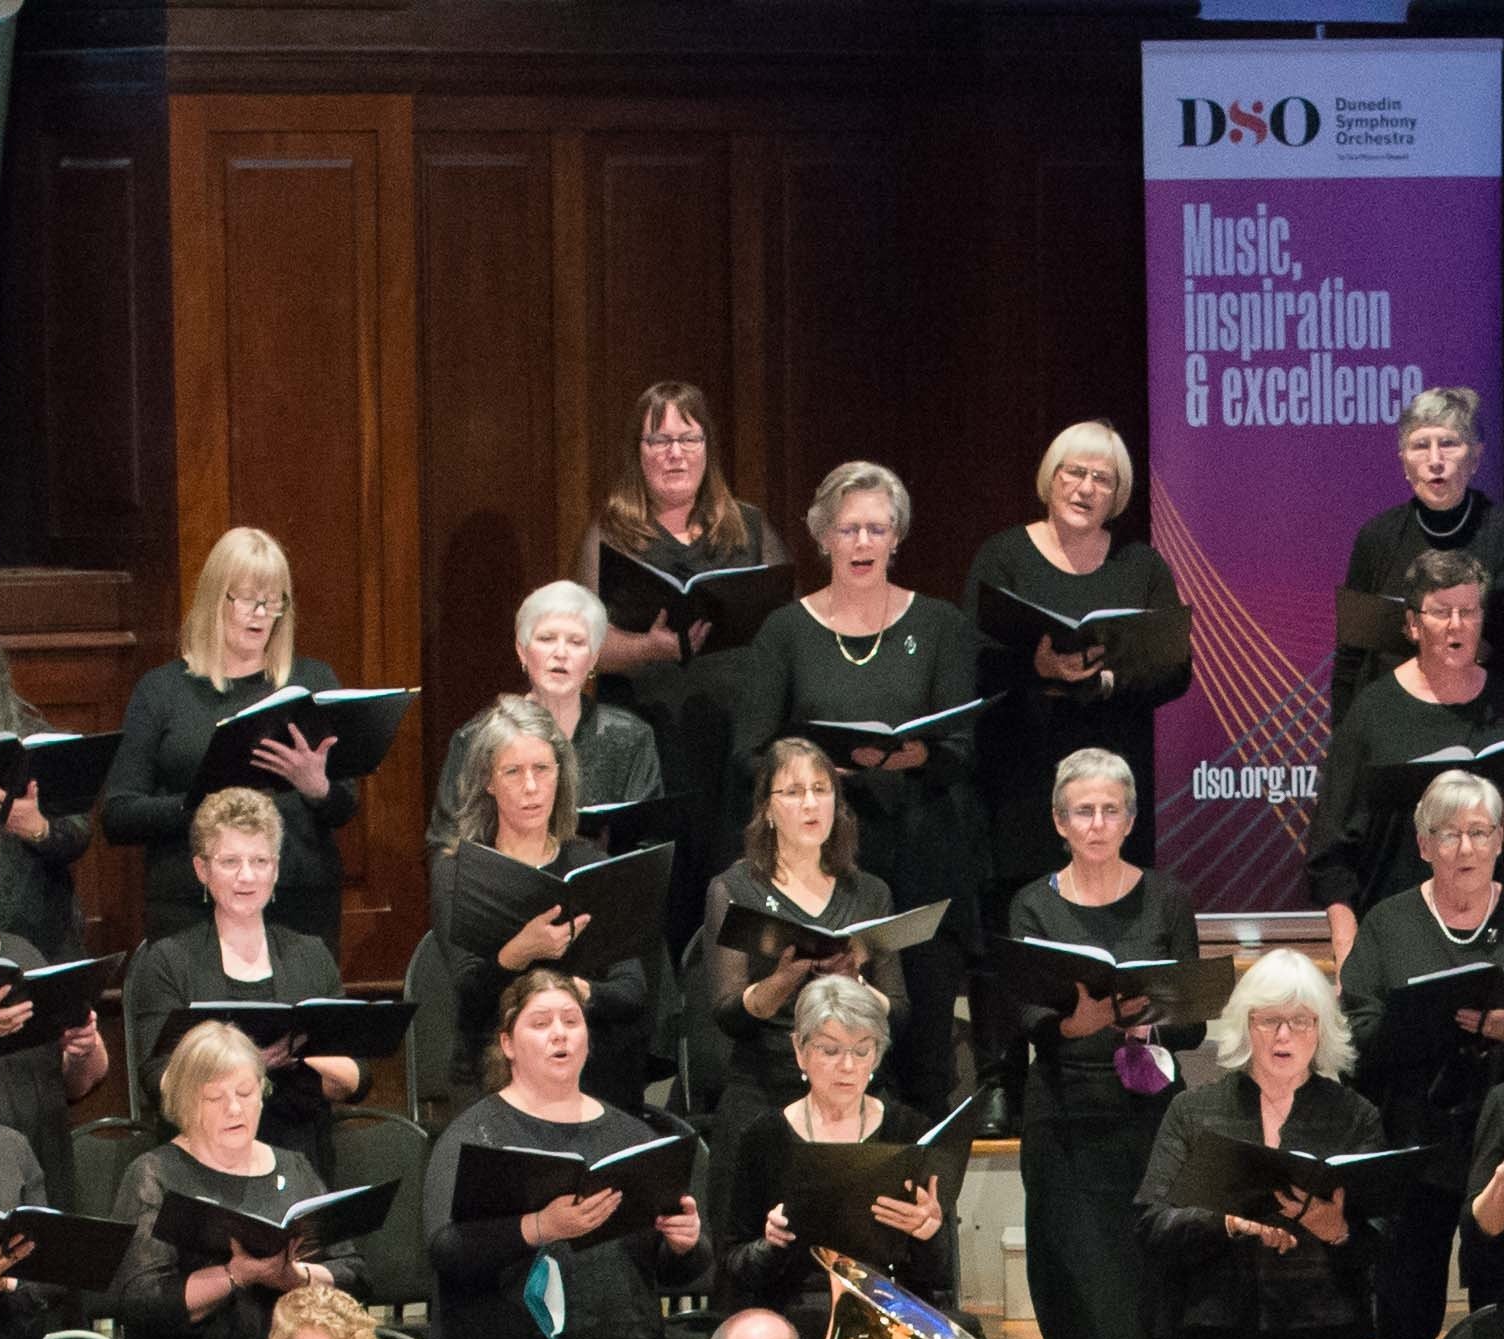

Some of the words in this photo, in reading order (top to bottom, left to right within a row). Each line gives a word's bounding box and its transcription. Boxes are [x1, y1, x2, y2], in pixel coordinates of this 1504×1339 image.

[1177, 96, 1321, 148] DSO
[1335, 97, 1402, 111] Dunedin
[1335, 114, 1417, 131] Symphony
[1335, 131, 1415, 145] Orchestra
[1182, 203, 1302, 281] Music,
[1184, 278, 1391, 360] inspiration
[1185, 354, 1211, 427] &
[1192, 760, 1318, 804] dso.org.nz
